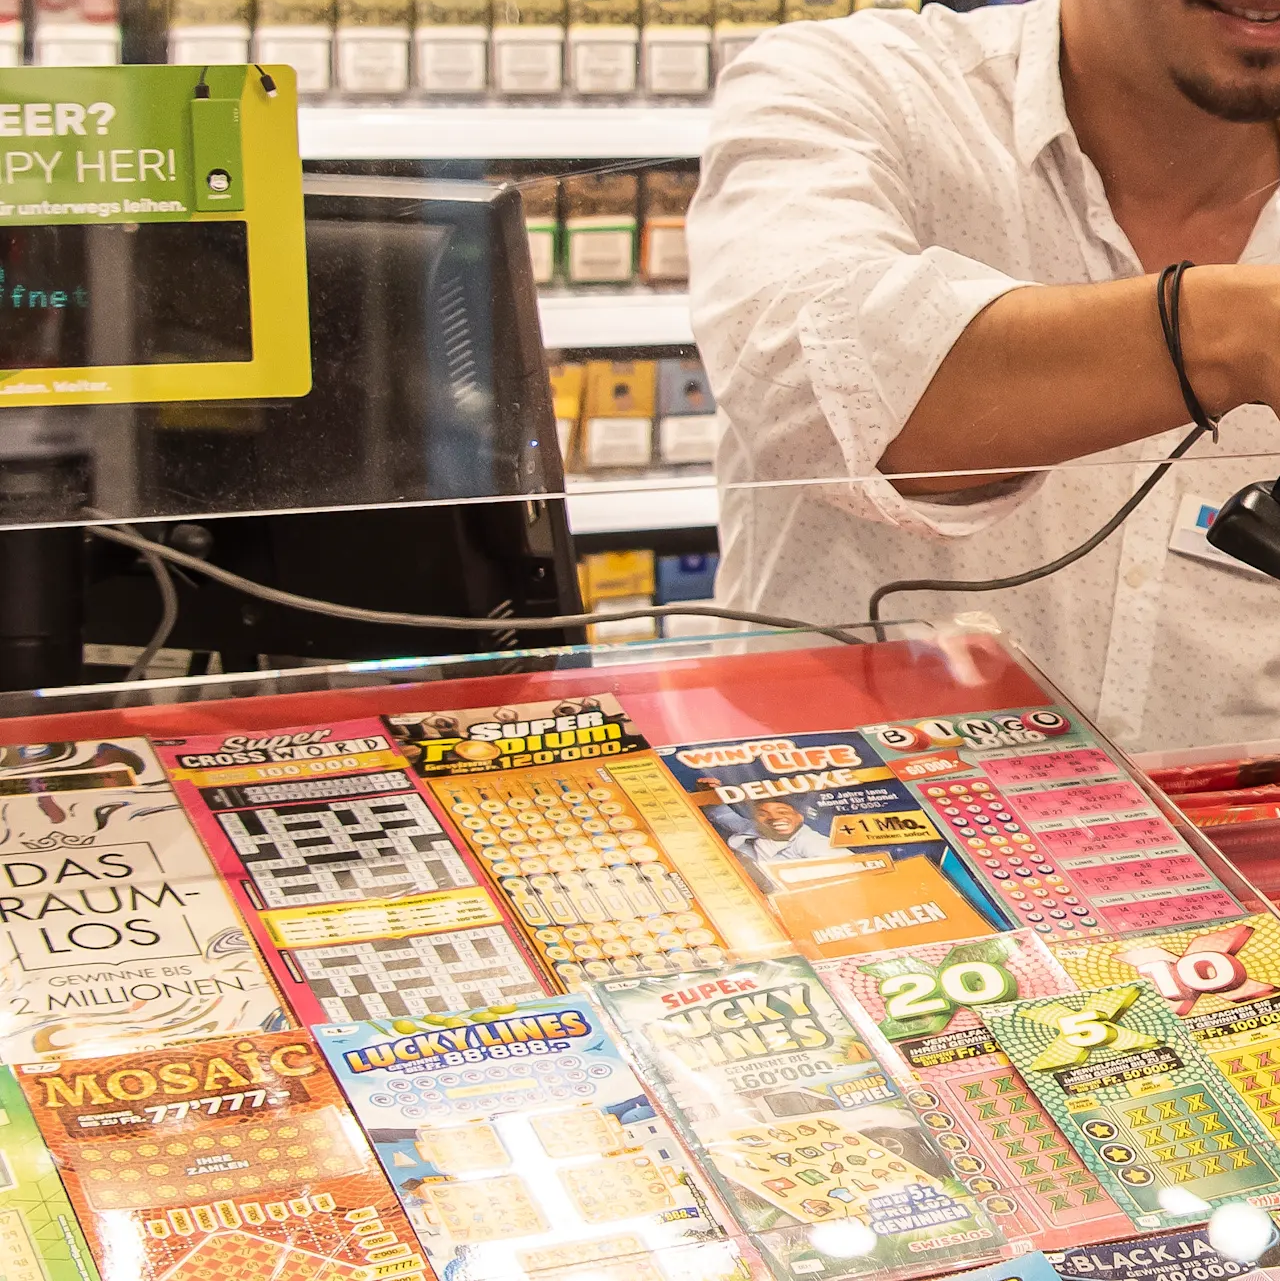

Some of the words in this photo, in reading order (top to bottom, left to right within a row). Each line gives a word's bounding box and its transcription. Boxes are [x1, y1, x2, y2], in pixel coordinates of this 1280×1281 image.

[76, 149, 177, 183] HER!
[19, 200, 121, 216] unterwegs
[123, 199, 186, 214] leihen.
[469, 711, 604, 741] SUPER
[882, 712, 1061, 745] BINGO
[219, 728, 332, 754] Super
[683, 749, 748, 766] WIN
[749, 742, 791, 753] FOR
[500, 740, 637, 769] 120'000.-
[766, 747, 857, 770] LIFE
[715, 768, 861, 805] DELUXE
[836, 790, 863, 799] Jahre
[865, 788, 887, 797] lang
[816, 798, 848, 808] Monat
[866, 793, 898, 802] Monat
[903, 830, 931, 838] sofort
[3, 853, 134, 888] DAS
[0, 882, 201, 922] RAUM-
[811, 918, 858, 944] IHRE
[857, 901, 947, 934] ZAHLEN
[40, 919, 161, 955] LOS
[48, 967, 158, 989] GEWINNE
[163, 965, 192, 977] BIS
[1138, 951, 1236, 1000] 10
[10, 996, 34, 1016] 2
[48, 976, 246, 1011] MILLIONEN
[661, 976, 758, 1010] SUPER
[880, 960, 1007, 1020] 20
[1198, 1012, 1239, 1029] GEWINN
[1239, 1009, 1256, 1020] BIS
[1257, 1005, 1272, 1015] ZU
[1255, 1000, 1271, 1009] SIE
[1058, 1010, 1107, 1047] 5
[1207, 1026, 1228, 1038] Fr.
[344, 1030, 474, 1075] LUCKY
[477, 1011, 592, 1047] LINES
[444, 1040, 571, 1066] 88'888.-
[910, 1043, 947, 1056] IHREN
[957, 1046, 980, 1058] Fr.
[724, 1057, 786, 1076] GEWINNE
[789, 1053, 810, 1065] BIS
[1064, 1072, 1093, 1084] IHREN
[1094, 1065, 1129, 1079] GEWINN
[1131, 1061, 1146, 1069] BIS
[1070, 1053, 1142, 1076] VERVIELFACHEN
[1143, 1050, 1156, 1060] SIE
[1103, 1076, 1122, 1088] Fr.
[1124, 1062, 1177, 1080] 50'000.-
[831, 1075, 887, 1095] BONUS
[839, 1084, 895, 1108] SPIEL
[144, 1090, 290, 1124] 77'777.-
[186, 1159, 250, 1176] ZAHLEN
[196, 1153, 233, 1166] IHRE
[872, 1206, 969, 1234] GEWINNEN
[910, 1229, 993, 1251] SWISSLOS
[1126, 1263, 1182, 1279] GEWINNE
[1183, 1260, 1201, 1269] BIS
[1203, 1256, 1219, 1265] ZU
